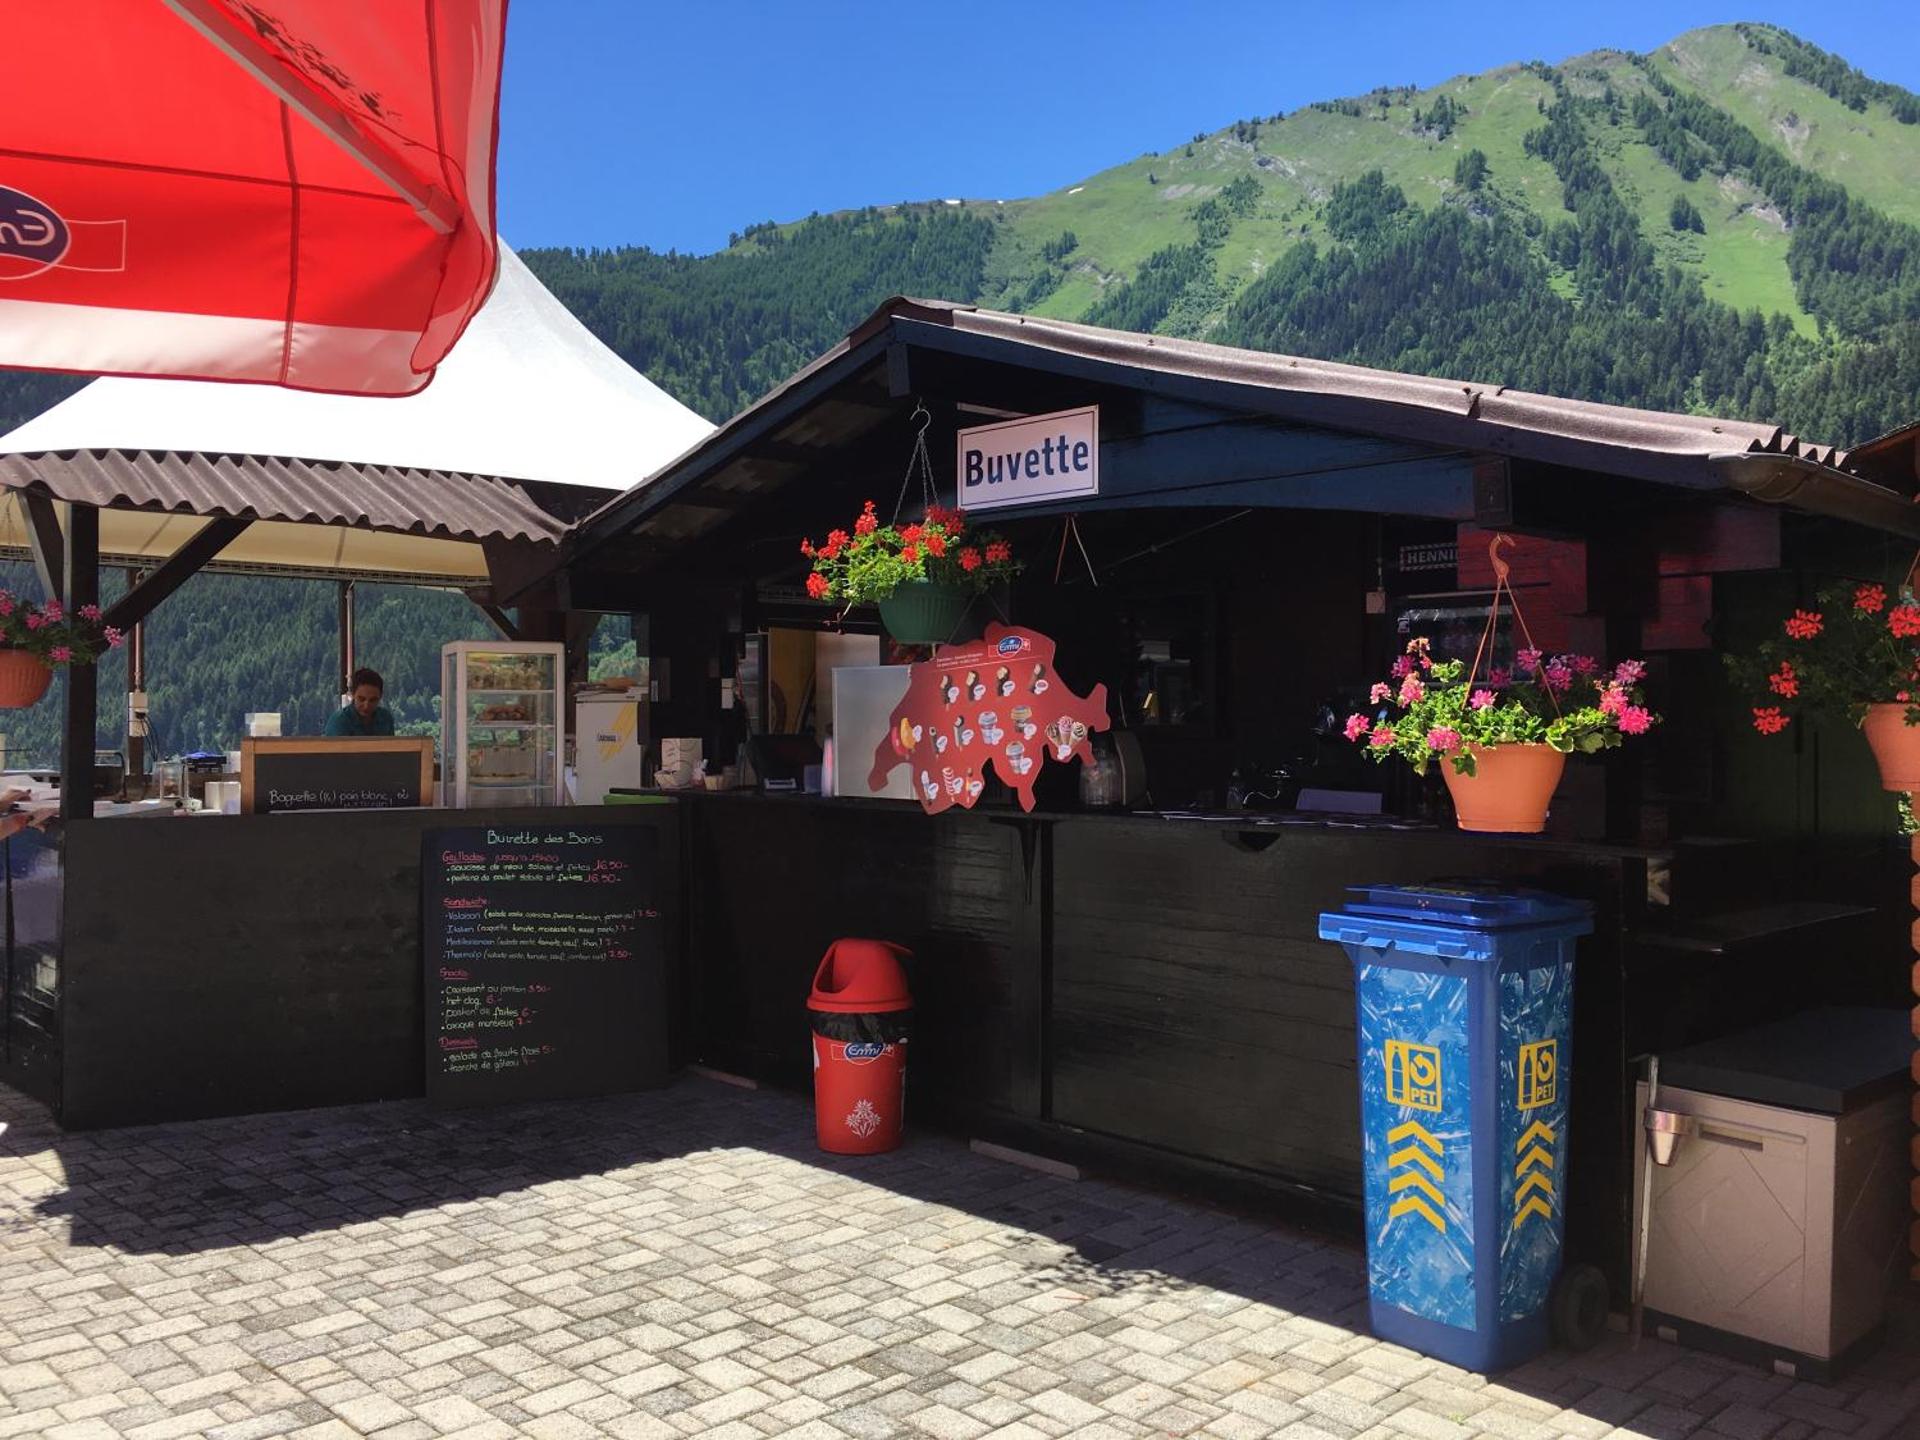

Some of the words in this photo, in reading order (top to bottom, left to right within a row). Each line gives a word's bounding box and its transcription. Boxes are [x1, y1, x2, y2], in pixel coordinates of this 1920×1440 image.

[966, 435, 1089, 487] Buvette
[1407, 548, 1458, 564] HENNI
[269, 789, 317, 807] Baguette
[486, 830, 538, 845] Buvette
[544, 834, 564, 844] des
[848, 1045, 881, 1056] Emmi
[1410, 1088, 1438, 1106] PET
[1536, 1083, 1553, 1100] PET
